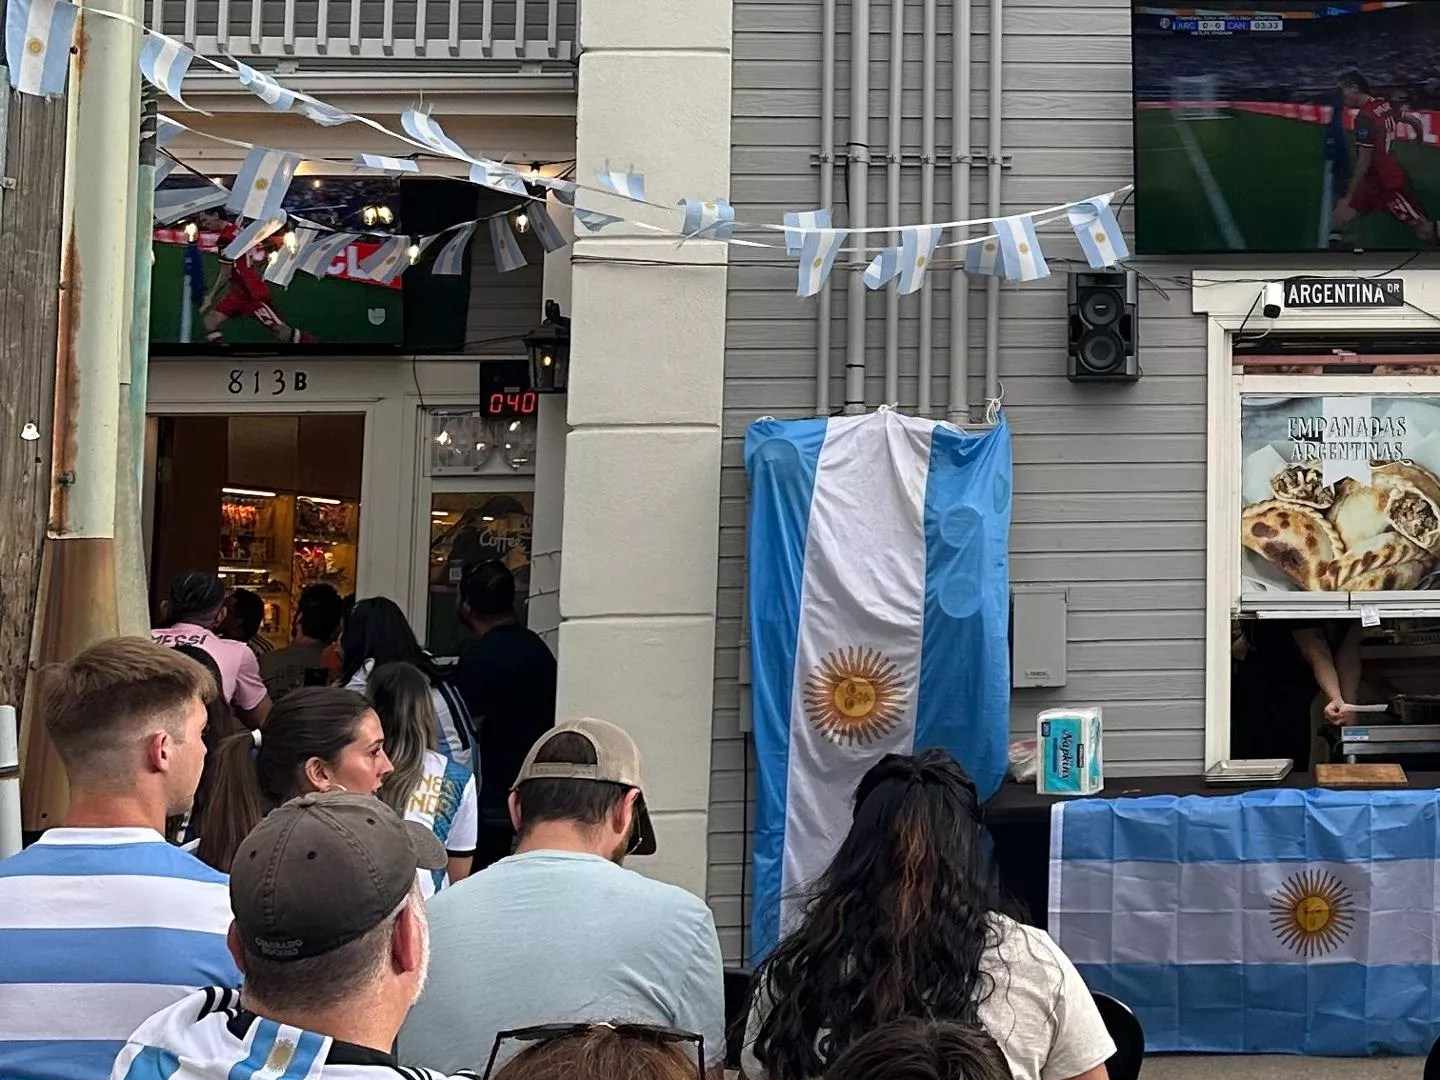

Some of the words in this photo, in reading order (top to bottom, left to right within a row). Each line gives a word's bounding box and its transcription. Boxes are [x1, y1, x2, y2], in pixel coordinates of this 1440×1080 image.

[1227, 21, 1247, 30] CAN
[1287, 283, 1386, 305] ARGENTINA
[1387, 283, 1401, 294] DR
[1287, 416, 1408, 439] EMPANADAS
[1290, 441, 1405, 462] ARGENTINAS
[1060, 728, 1073, 780] Napkins
